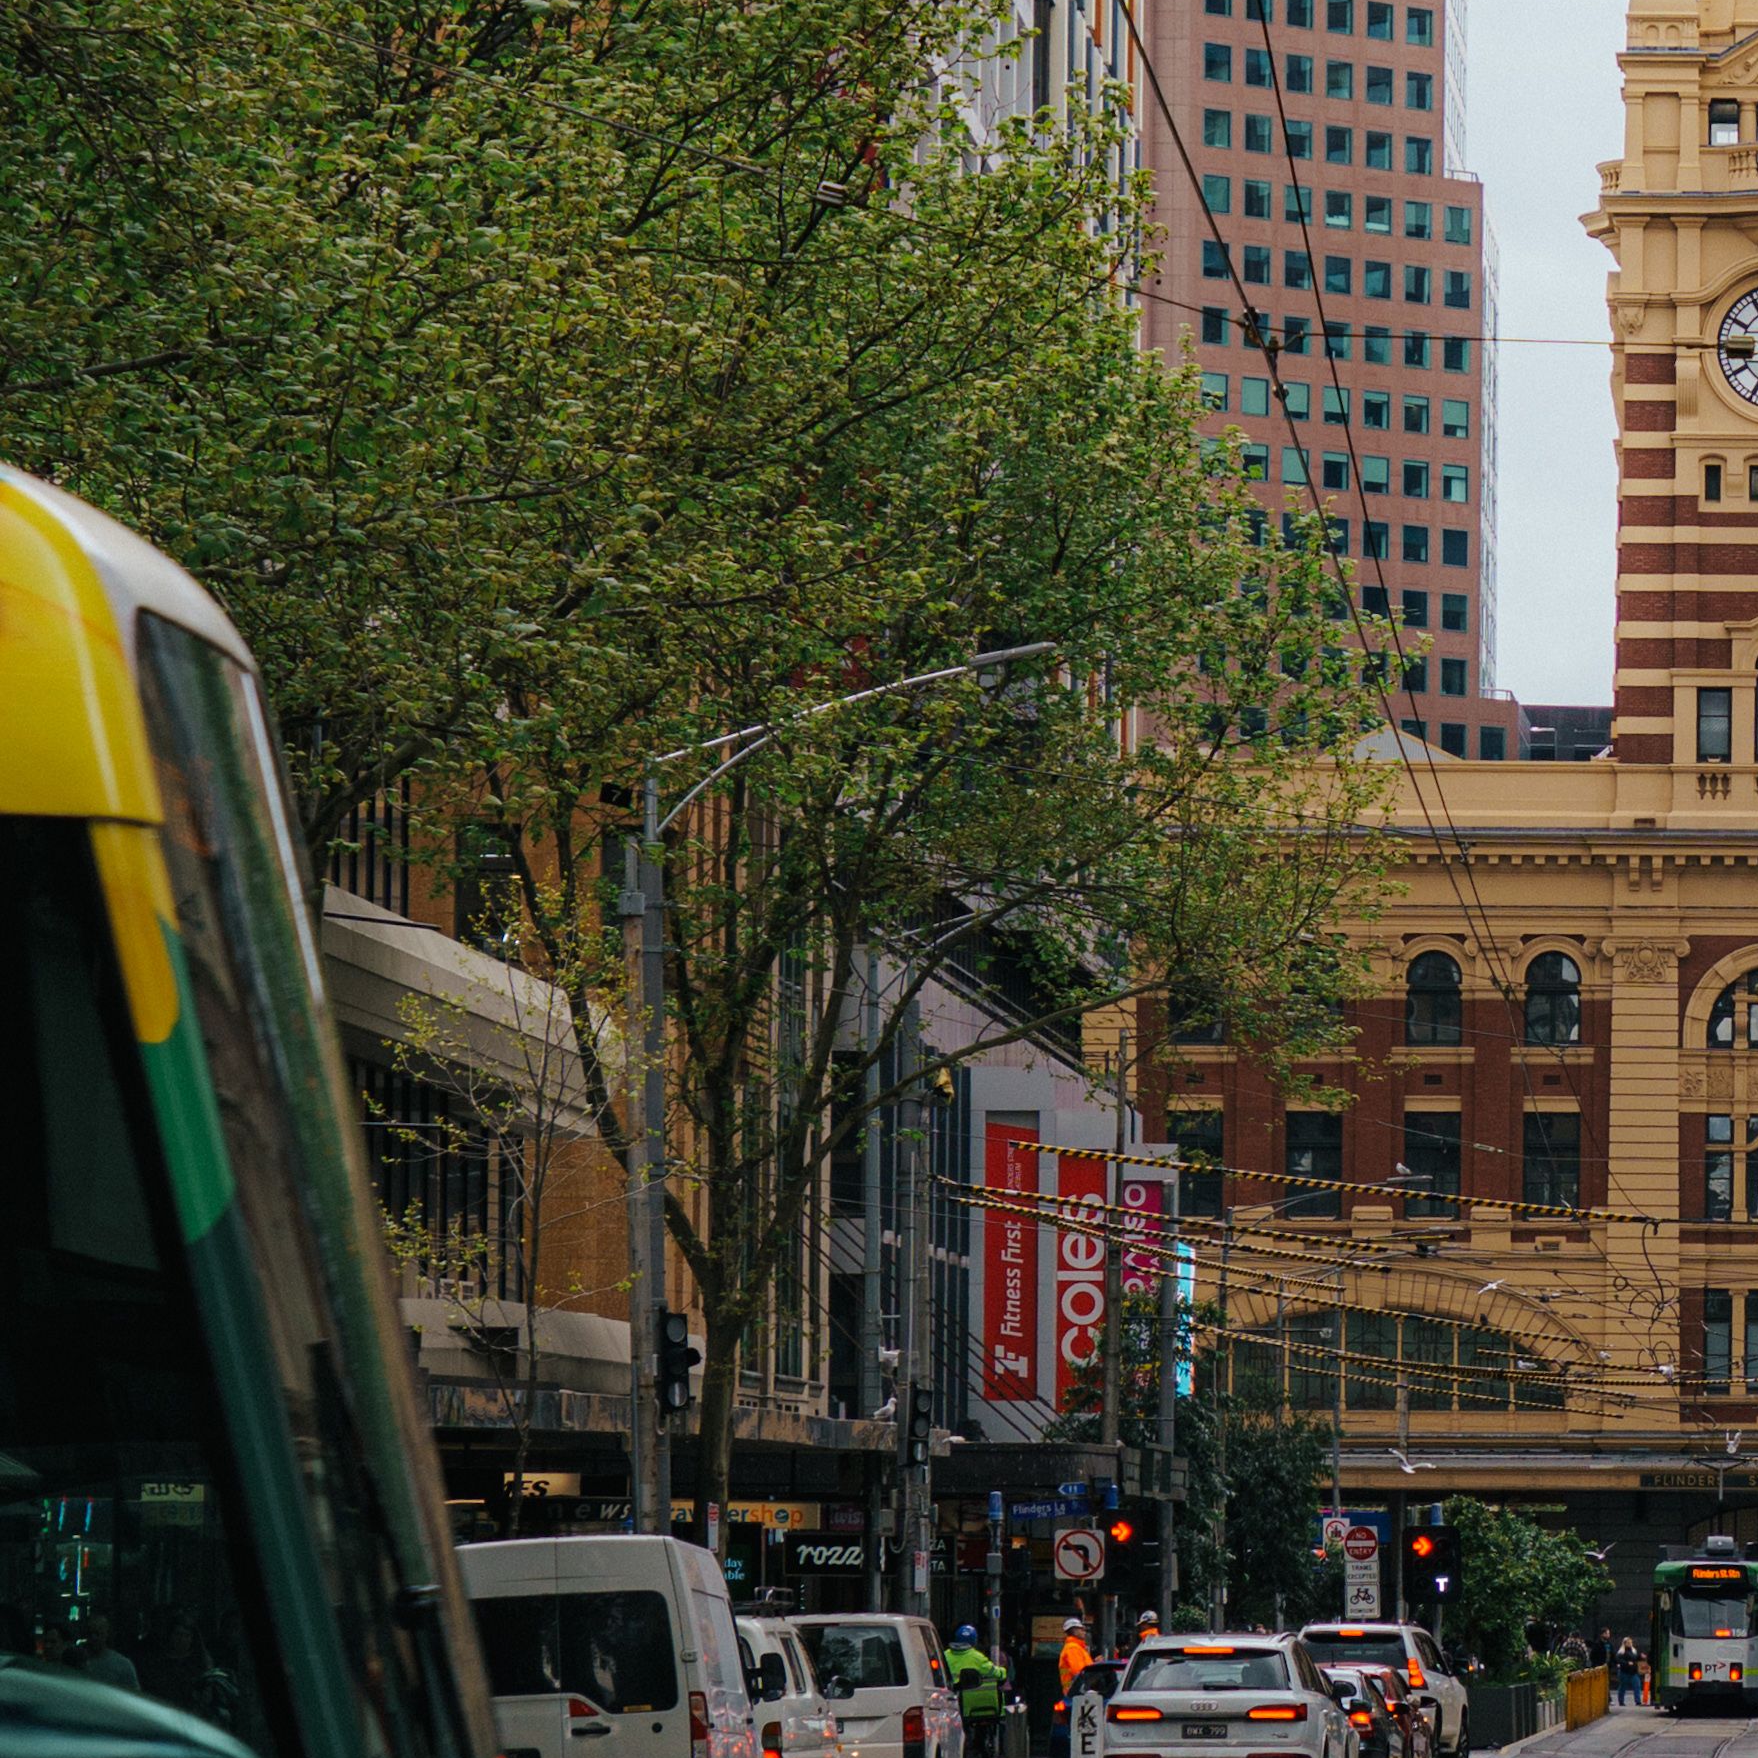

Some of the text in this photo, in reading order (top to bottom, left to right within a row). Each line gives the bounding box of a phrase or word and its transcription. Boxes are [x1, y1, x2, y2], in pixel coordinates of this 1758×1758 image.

[1001, 1221, 1023, 1338] Fitness First
[1057, 1193, 1105, 1368] coles
[1654, 1475, 1721, 1486] FLINDERS
[1012, 1503, 1052, 1515] Flinders
[1355, 1532, 1366, 1540] NO
[1350, 1547, 1373, 1555] ENTRY
